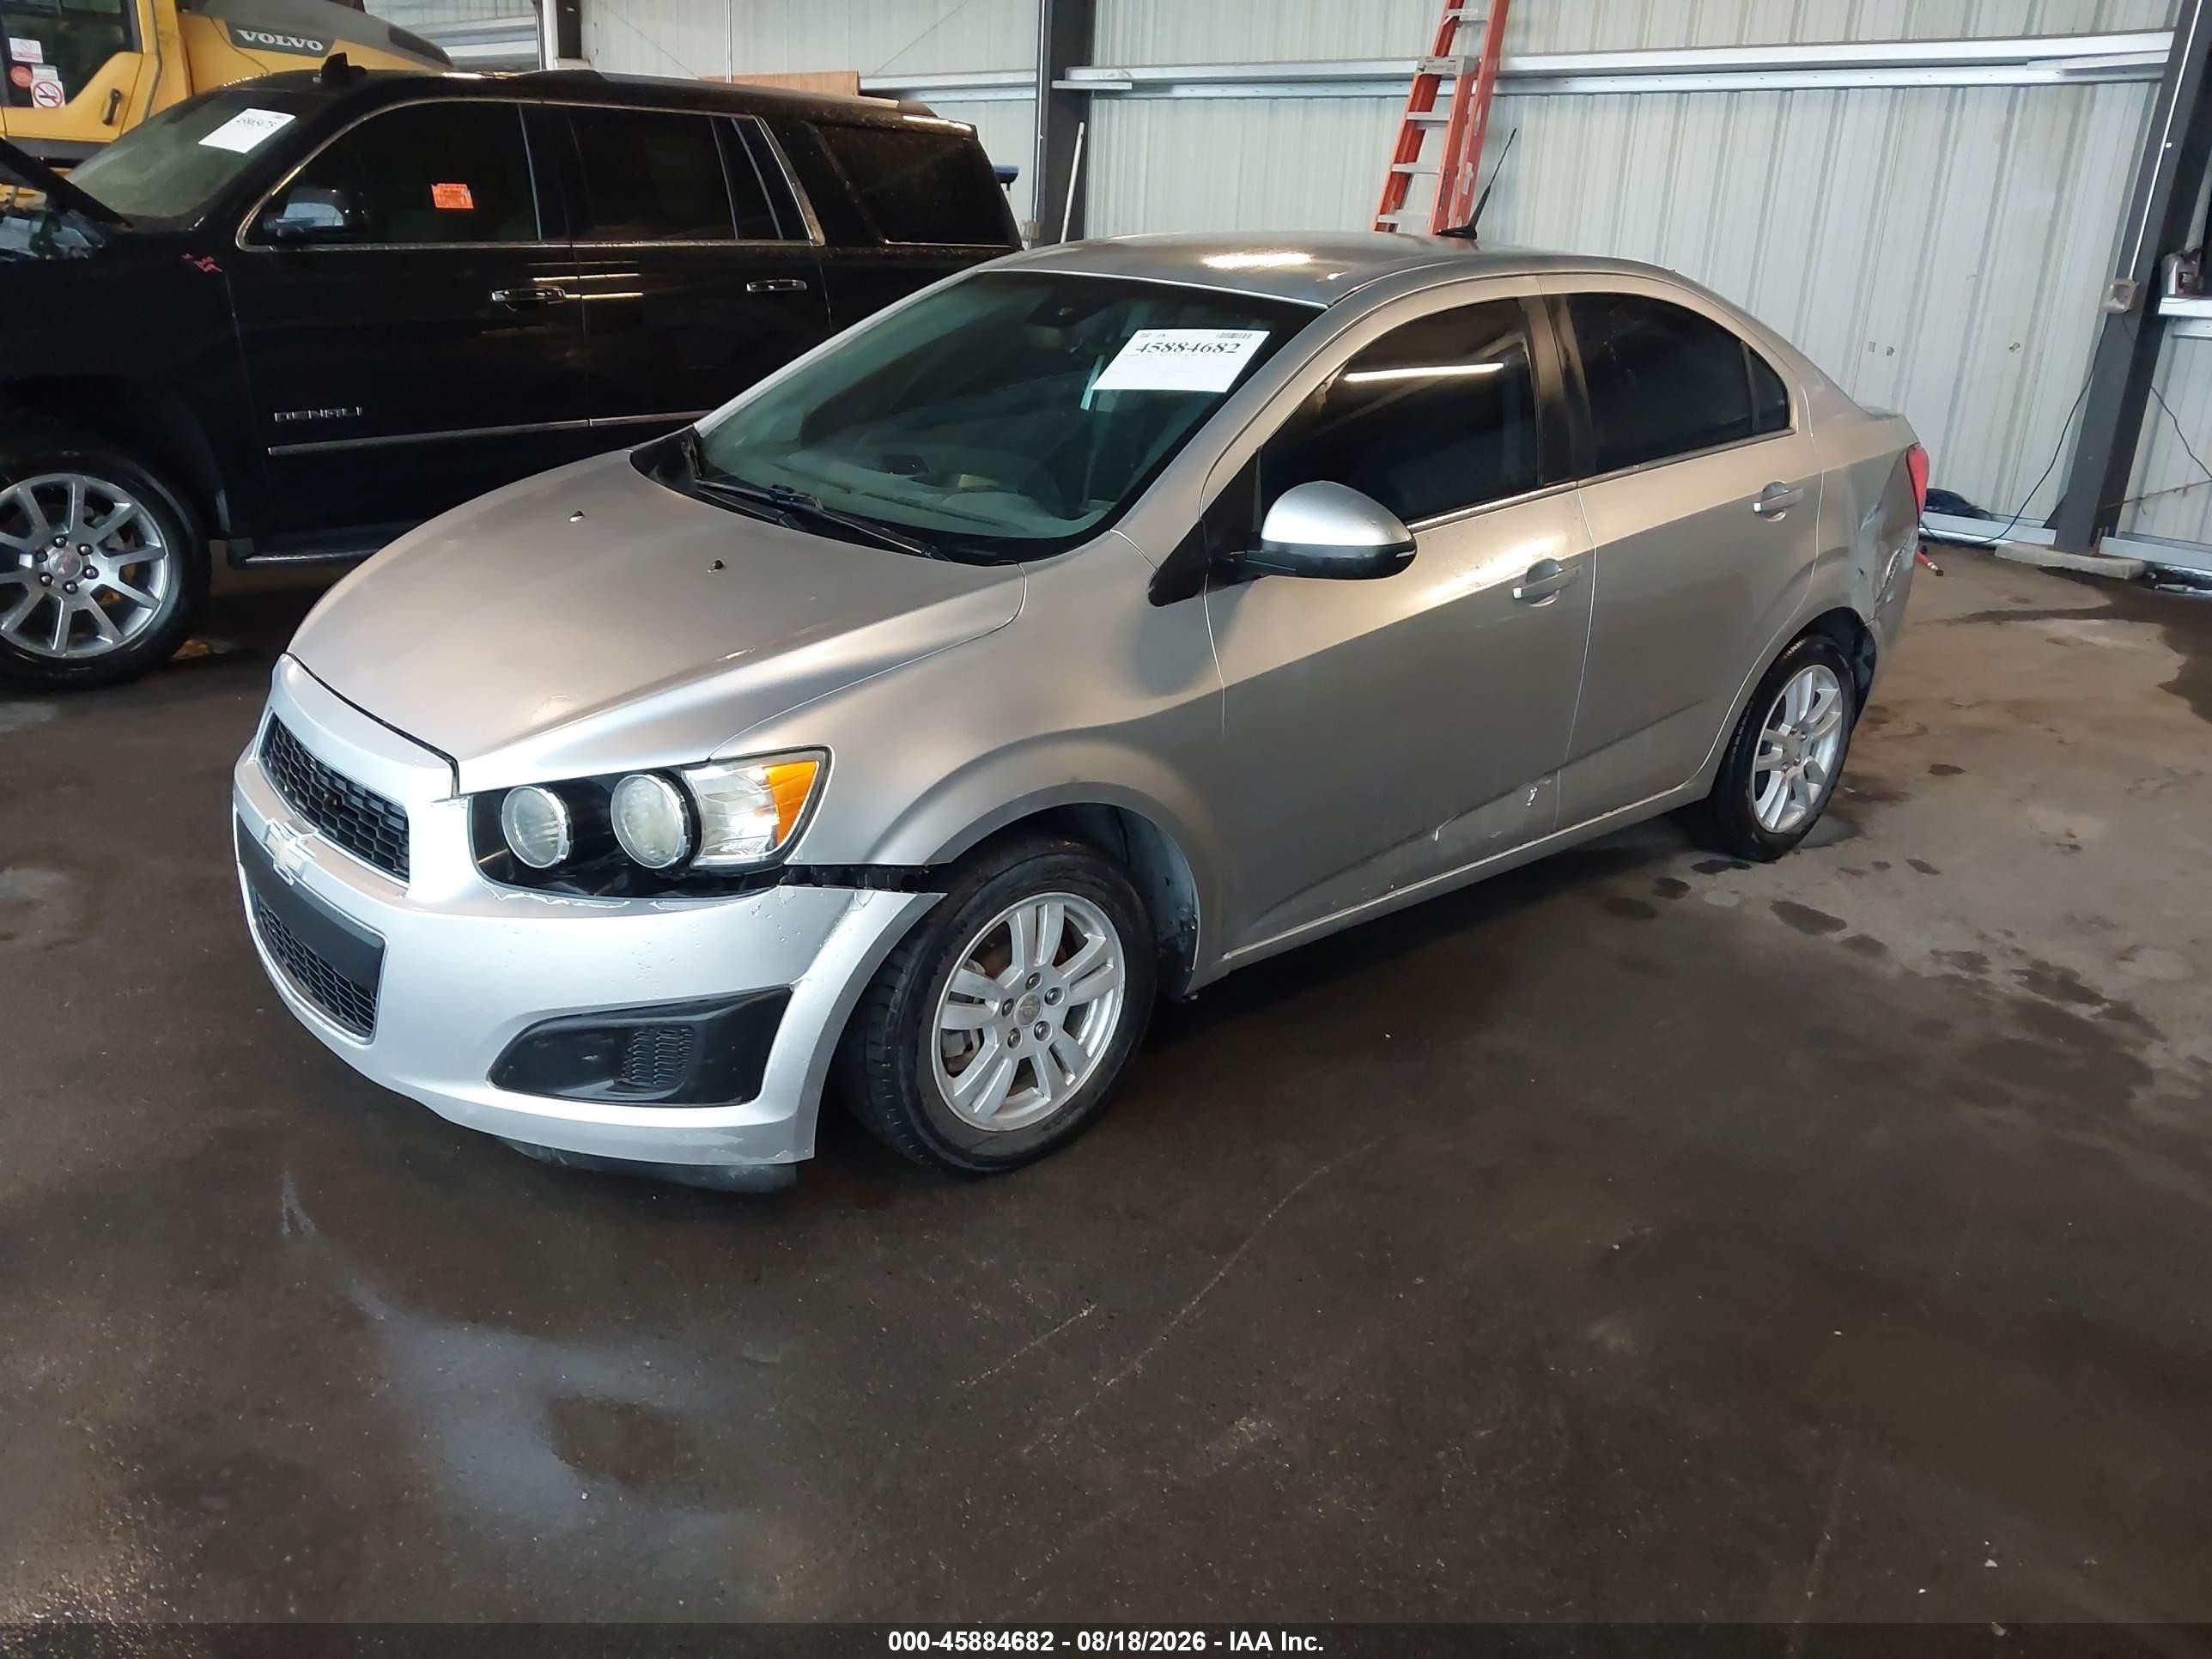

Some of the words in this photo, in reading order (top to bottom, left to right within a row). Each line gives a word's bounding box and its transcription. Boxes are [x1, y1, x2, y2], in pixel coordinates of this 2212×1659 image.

[236, 28, 324, 52] VOLVO
[1135, 341, 1242, 354] 45884682
[274, 406, 362, 422] DENALI
